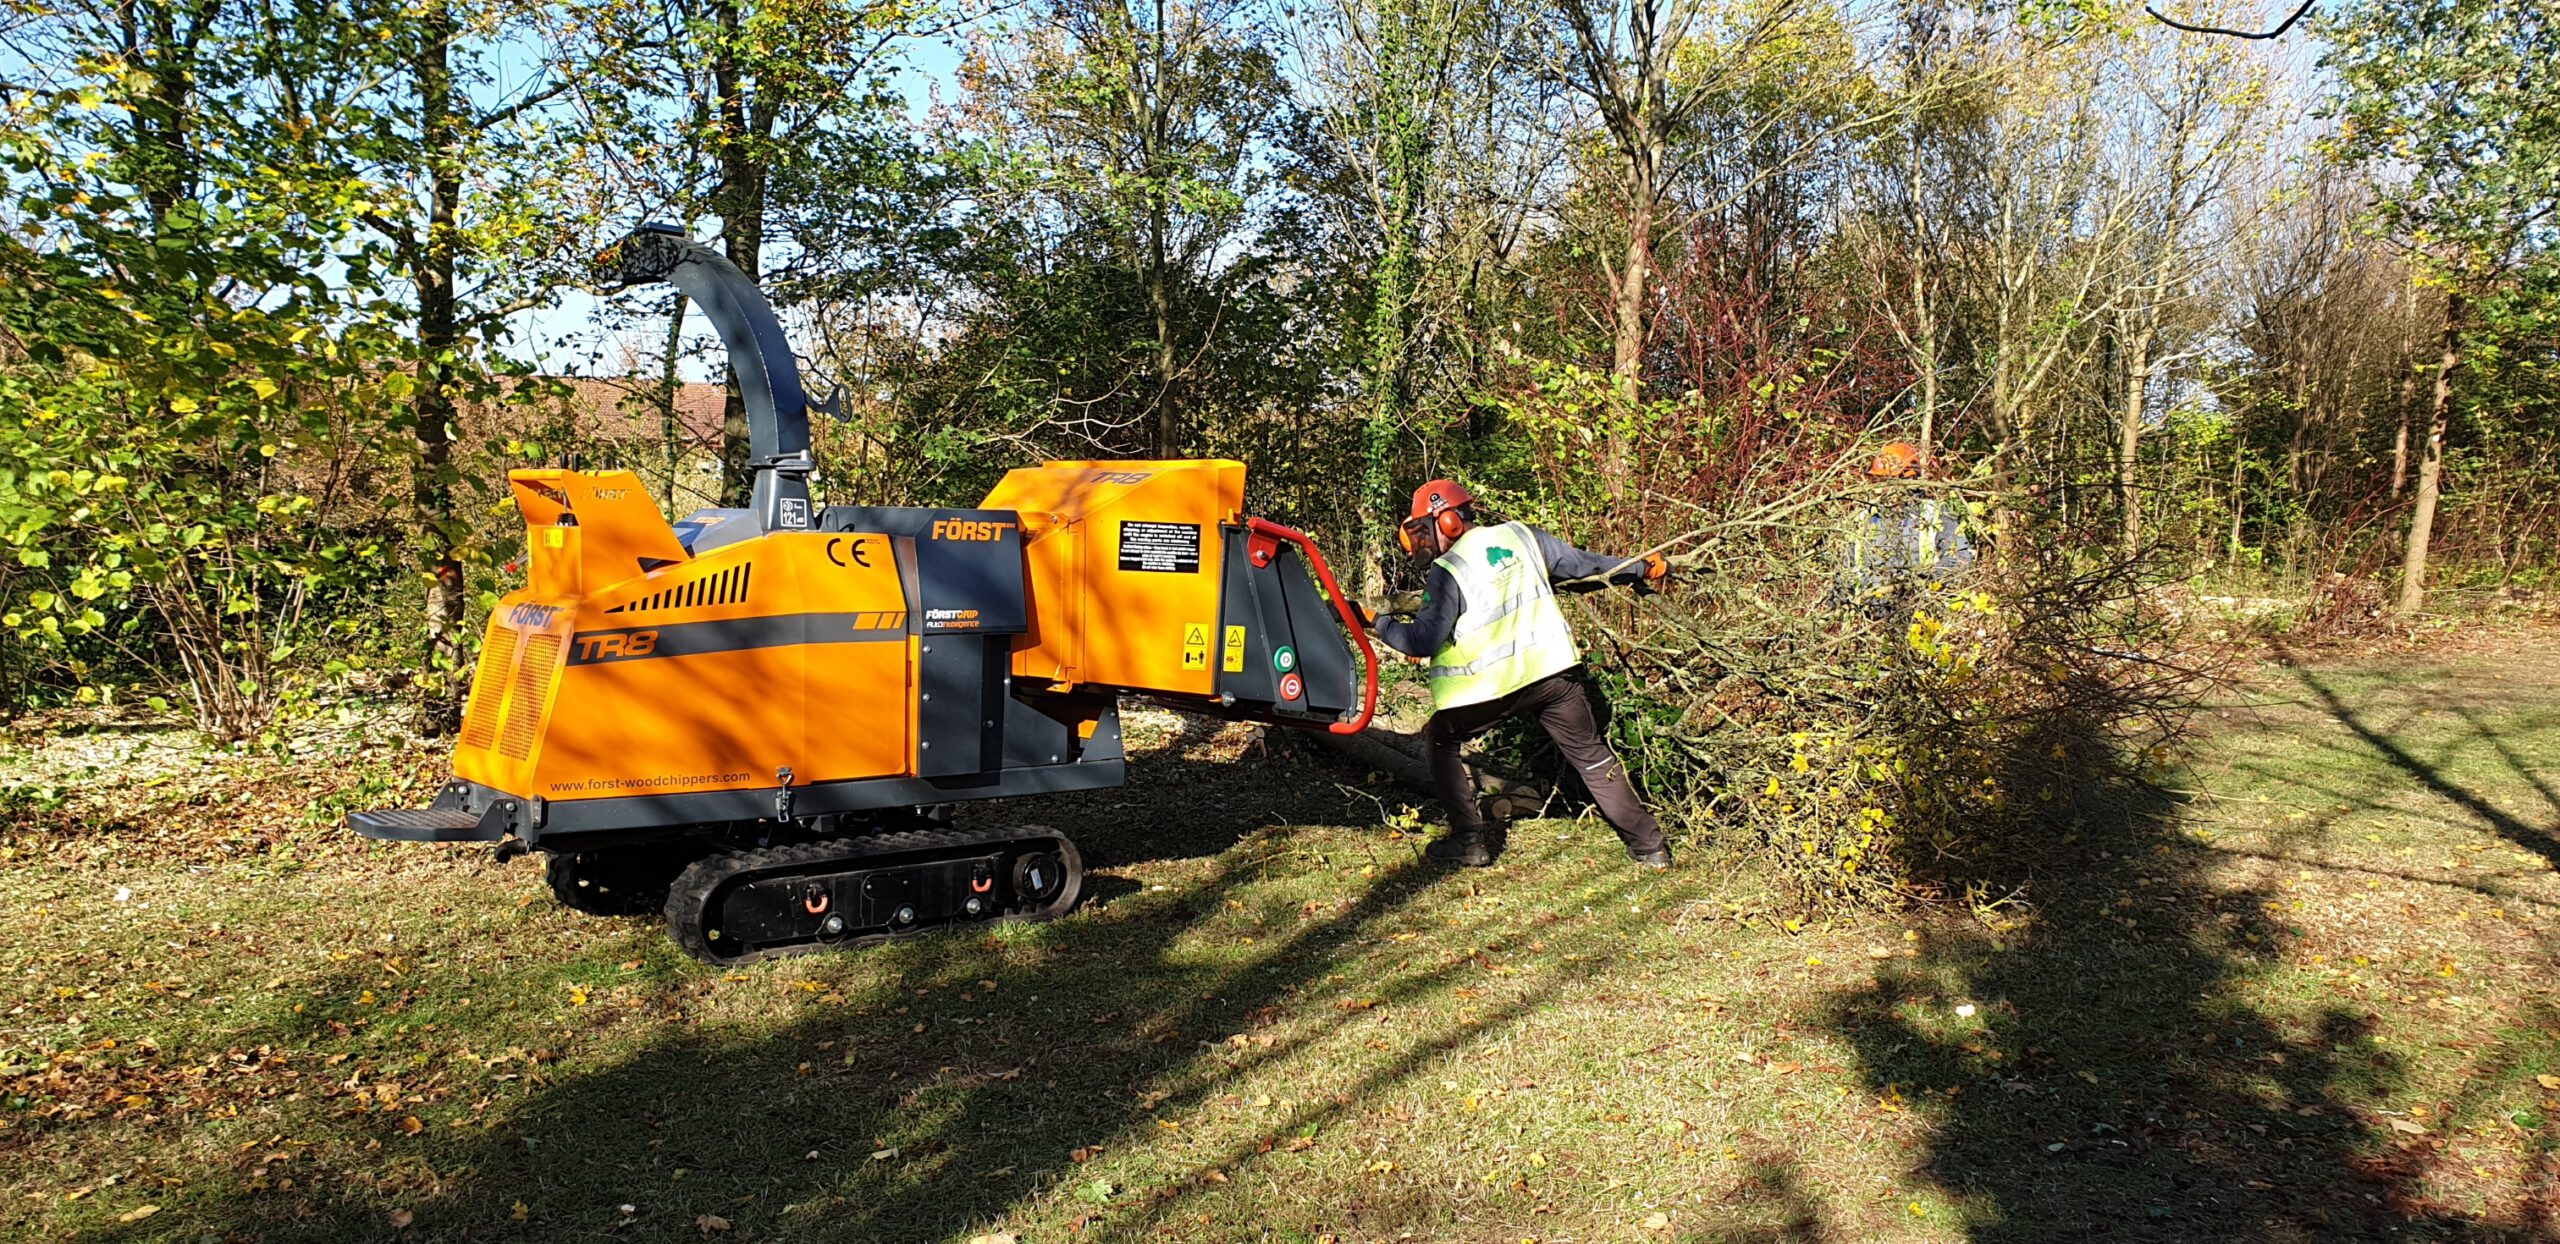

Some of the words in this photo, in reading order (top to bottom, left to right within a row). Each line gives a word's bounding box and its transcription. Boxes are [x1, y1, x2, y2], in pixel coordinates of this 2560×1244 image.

[1090, 471, 1153, 485] TR8
[783, 511, 797, 525] 121
[931, 517, 1004, 542] FÖRST
[826, 538, 871, 568] CE
[508, 600, 558, 628] FÖRST
[576, 630, 659, 661] TR8
[550, 772, 751, 792] www.forst-woodchippers.com
